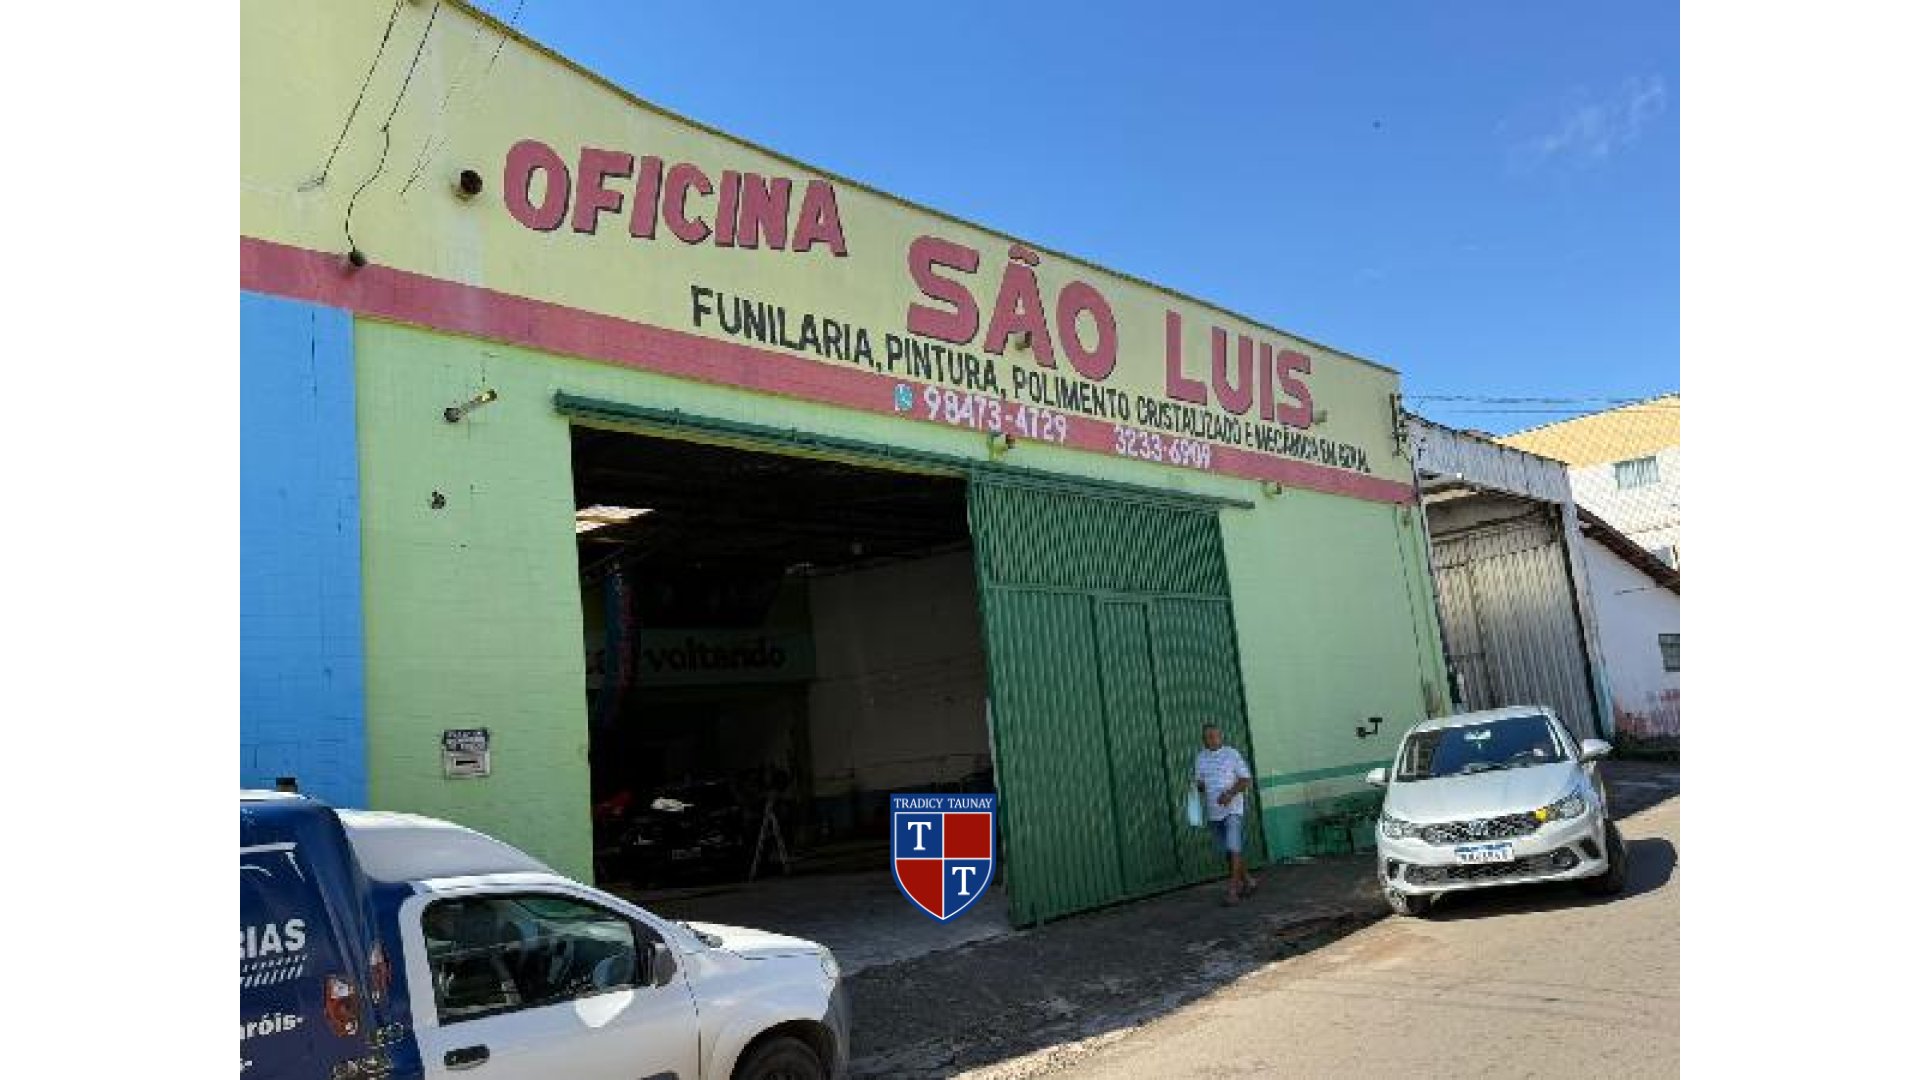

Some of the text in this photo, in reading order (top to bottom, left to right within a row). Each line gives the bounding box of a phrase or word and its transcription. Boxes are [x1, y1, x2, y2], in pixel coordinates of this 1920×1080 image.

[503, 139, 848, 257] OFICINA
[1166, 309, 1313, 430] LUIS
[690, 284, 882, 371] FUNILARIA,
[886, 333, 1006, 399] PINTURA,
[1012, 365, 1130, 421] POLIMENTO
[1137, 395, 1242, 445] CRISTALIZADO
[1245, 421, 1254, 447] E
[923, 384, 1067, 444] 98473-4729
